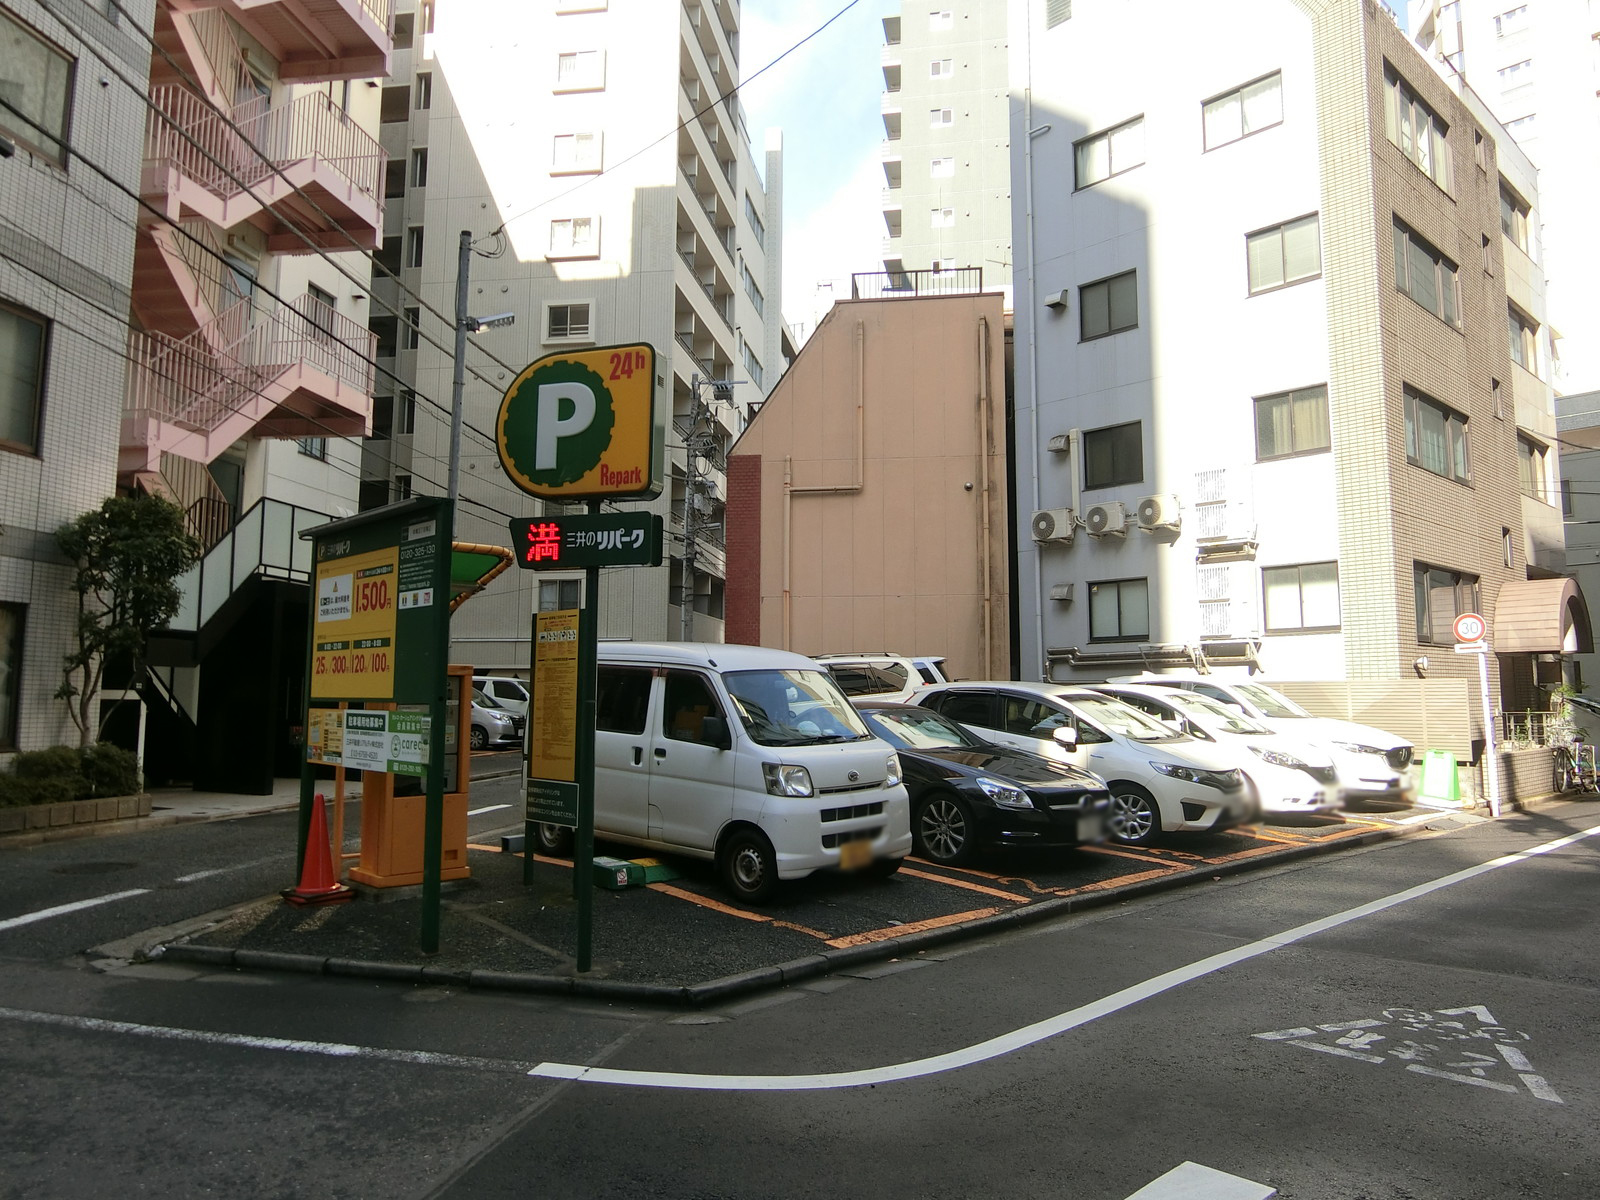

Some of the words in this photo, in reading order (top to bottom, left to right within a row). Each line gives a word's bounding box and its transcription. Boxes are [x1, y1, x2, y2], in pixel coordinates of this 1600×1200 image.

[609, 351, 646, 381] 24h
[535, 381, 597, 471] P
[600, 463, 642, 489] Repark
[526, 522, 561, 562] 満
[566, 528, 645, 551] 三井のリパーク
[1461, 622, 1479, 635] 30
[402, 740, 424, 751] carec
